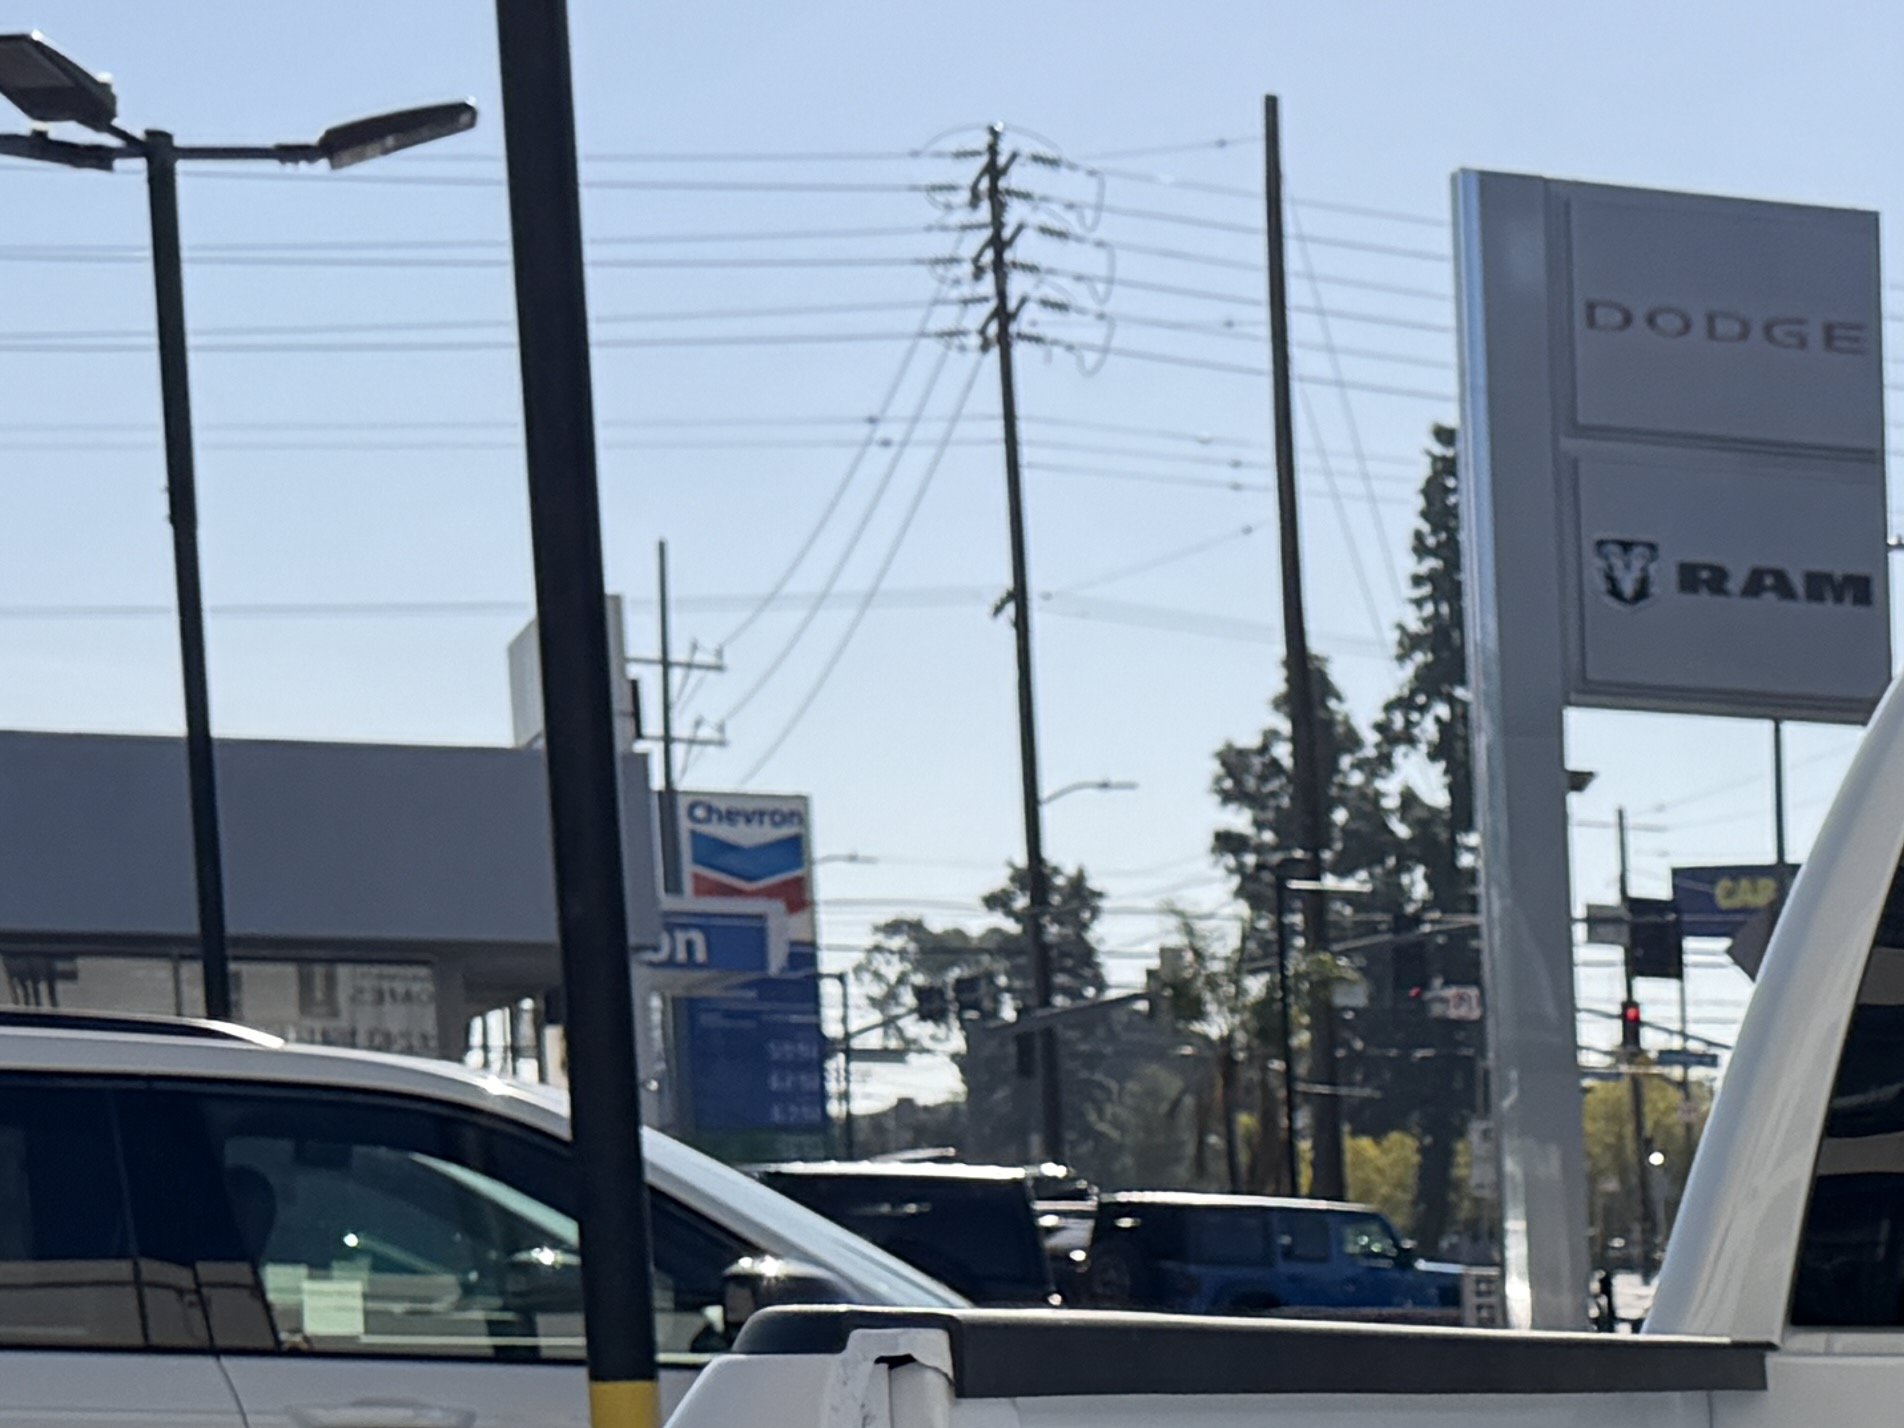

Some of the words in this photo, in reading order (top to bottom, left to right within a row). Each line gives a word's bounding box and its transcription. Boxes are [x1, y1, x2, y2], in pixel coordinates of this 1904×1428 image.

[1585, 299, 1868, 355] DODGE
[1676, 561, 1872, 607] RAM
[687, 800, 804, 829] Chevron
